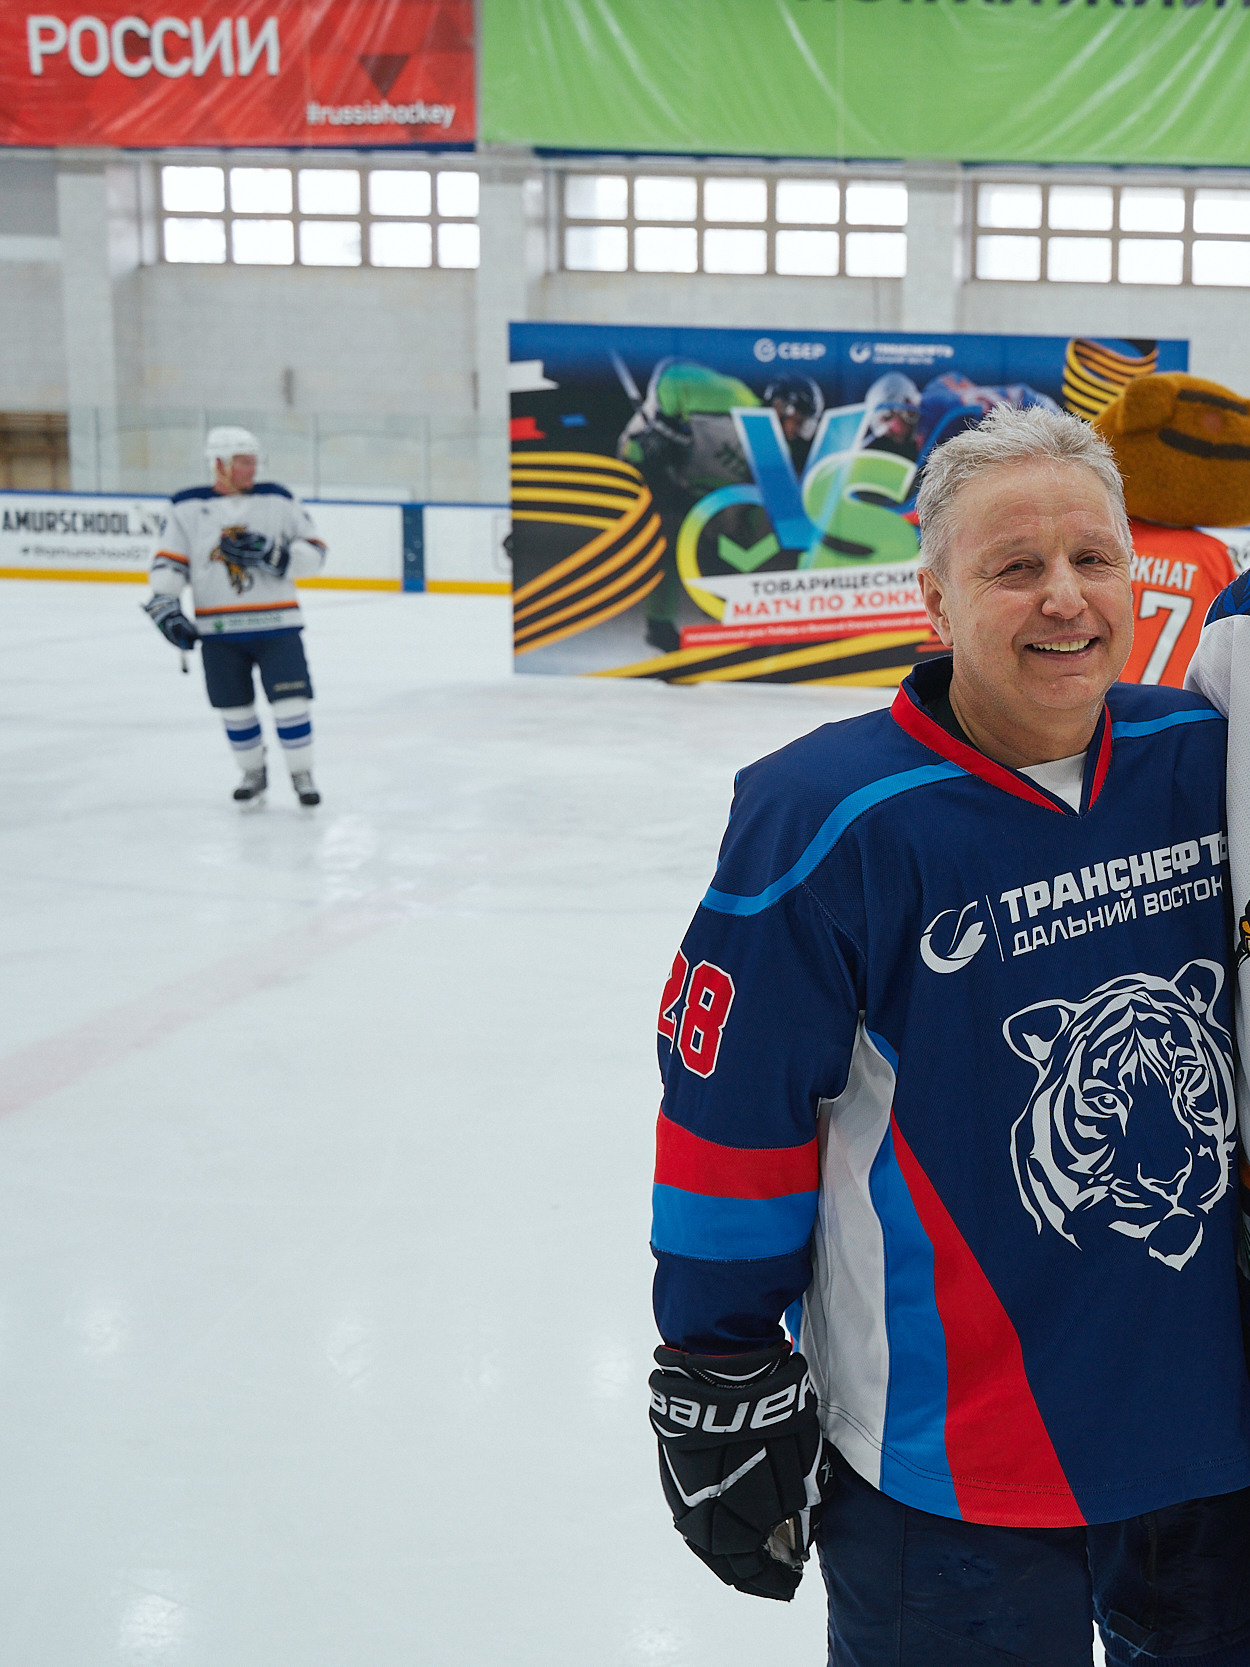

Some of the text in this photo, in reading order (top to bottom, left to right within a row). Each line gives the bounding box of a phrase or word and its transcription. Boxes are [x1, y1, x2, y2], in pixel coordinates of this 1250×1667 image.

[27, 15, 281, 78] РОССИИ
[307, 98, 456, 128] #russiahockey
[733, 586, 923, 618] МАТЧ ПО ХОКК
[1012, 874, 1223, 957] ДАЛЬНИЙ ВОСТОК
[657, 948, 736, 1079] 28
